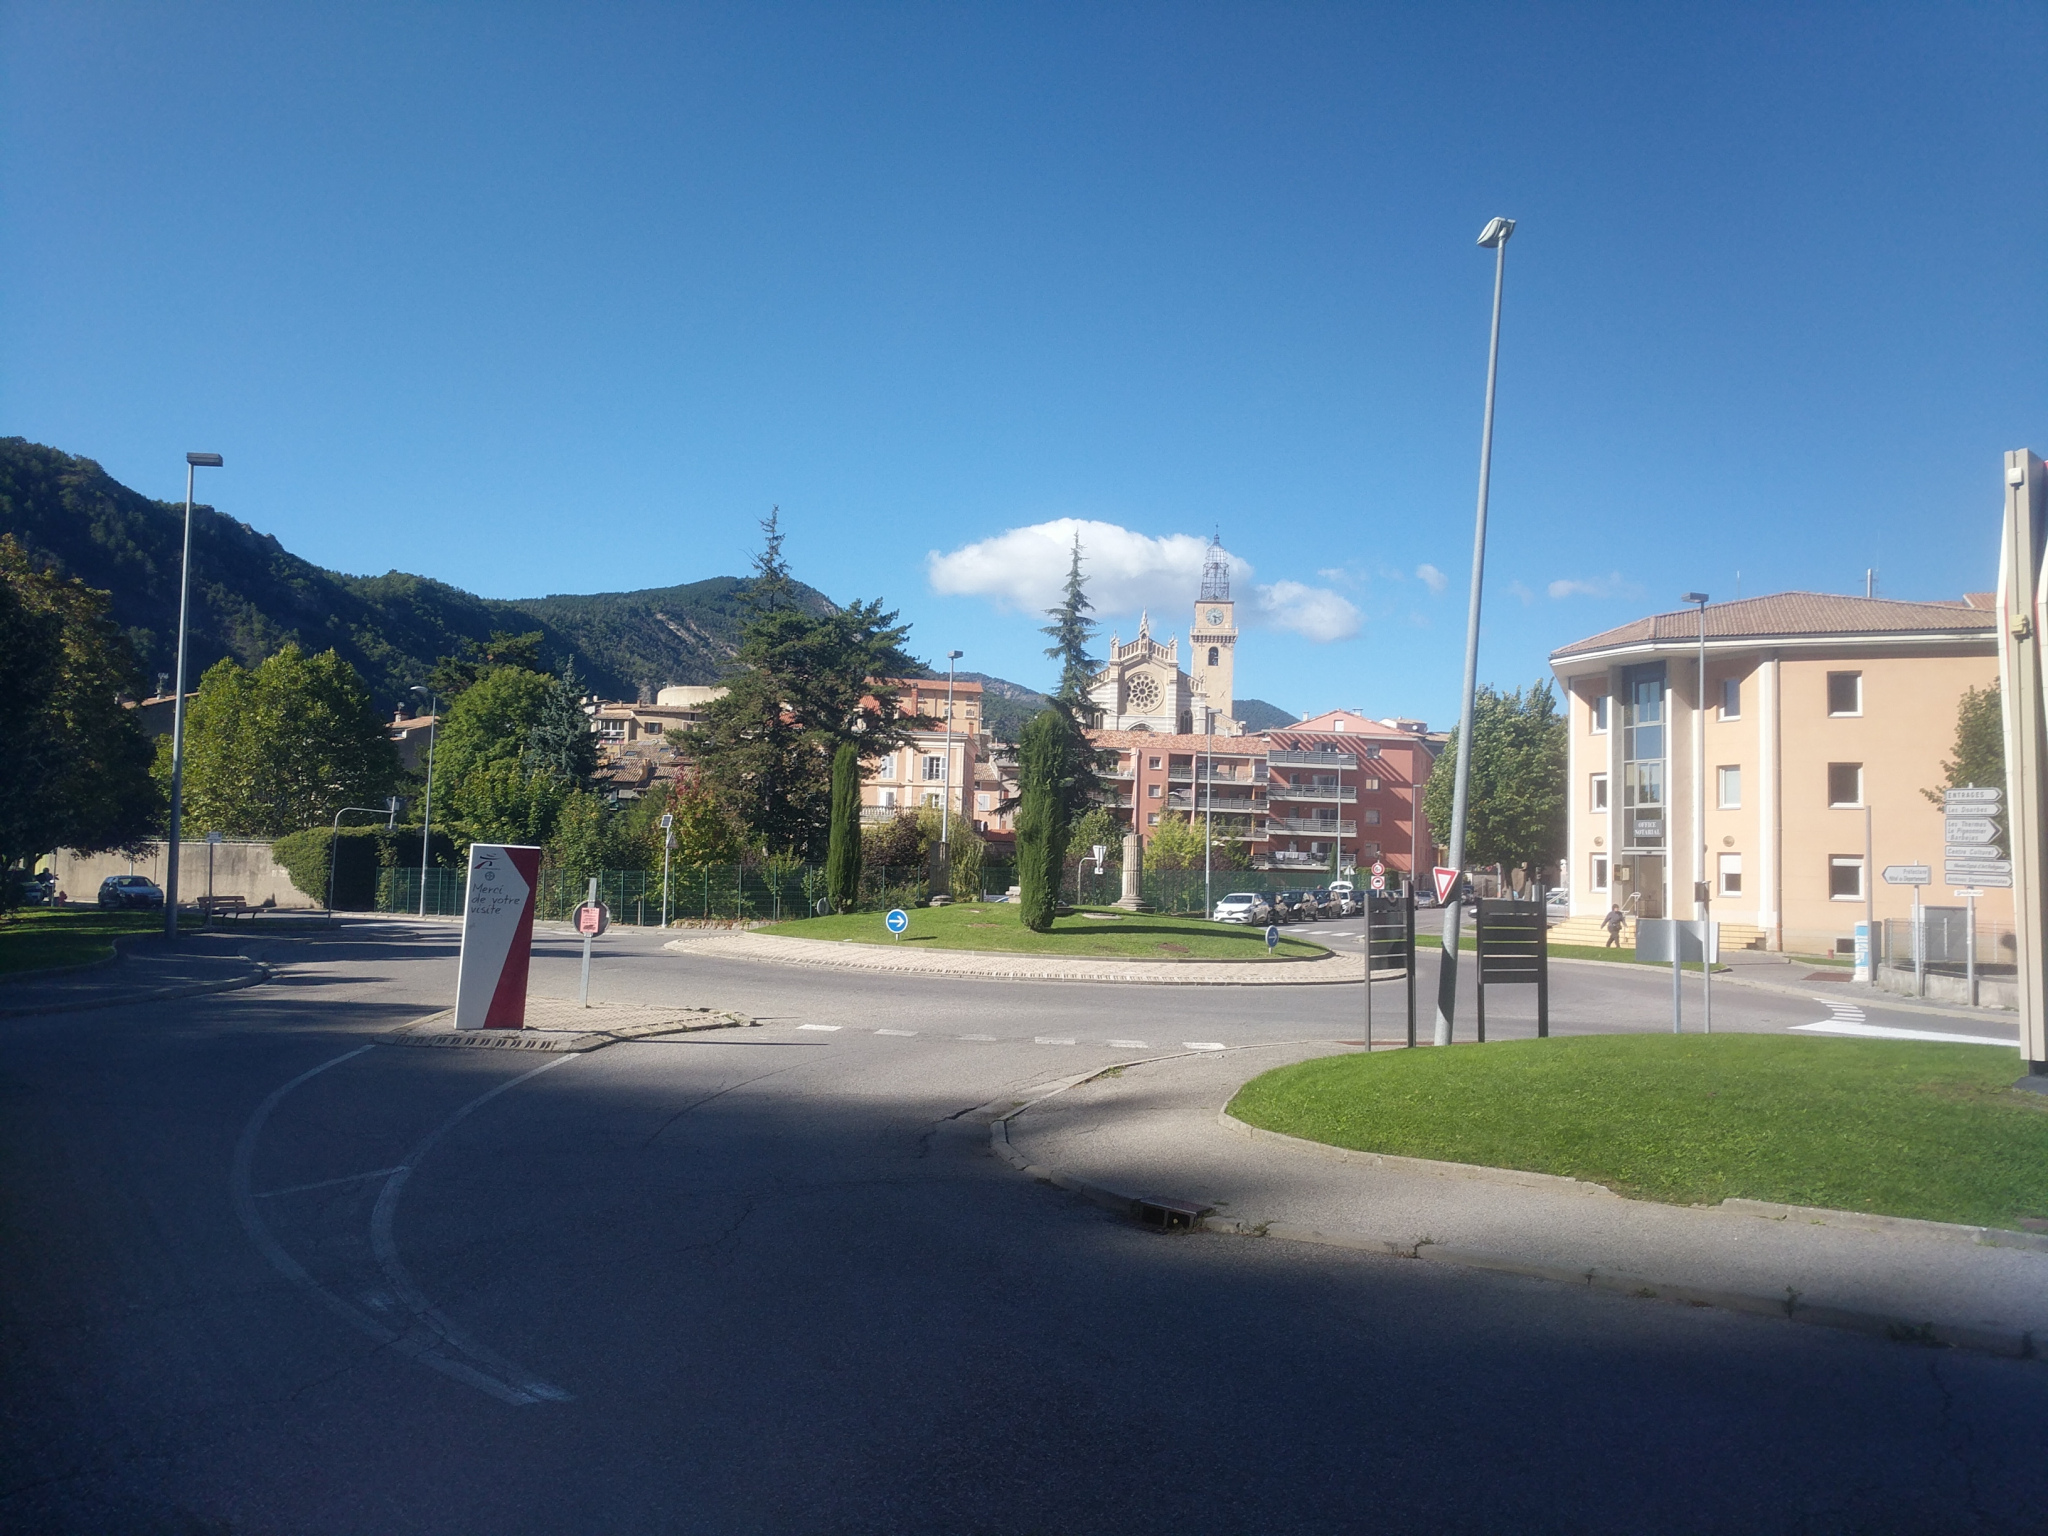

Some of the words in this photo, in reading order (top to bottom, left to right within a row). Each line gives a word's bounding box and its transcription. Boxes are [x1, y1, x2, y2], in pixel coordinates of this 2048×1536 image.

[1948, 791, 1985, 799] ENTRAGES
[472, 883, 504, 894] Merci
[471, 894, 486, 904] de
[492, 895, 520, 905] votre
[471, 904, 501, 914] visite
